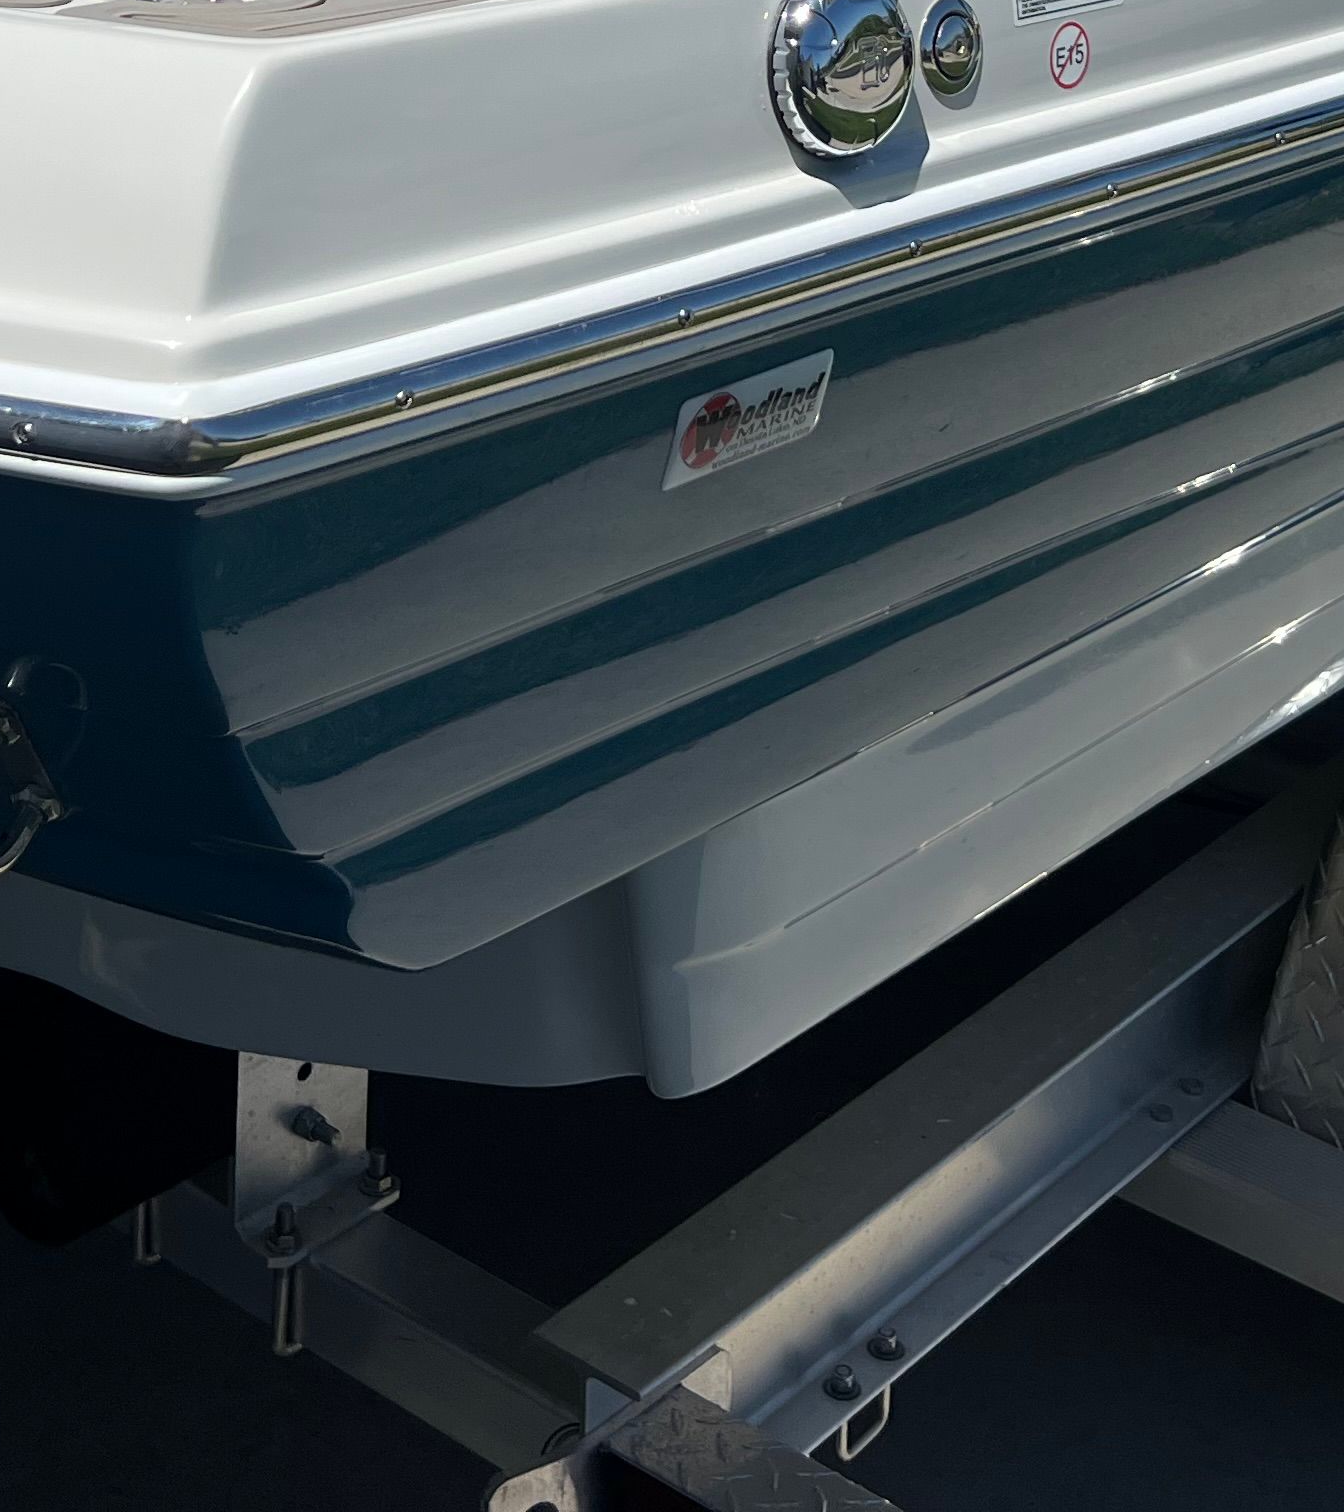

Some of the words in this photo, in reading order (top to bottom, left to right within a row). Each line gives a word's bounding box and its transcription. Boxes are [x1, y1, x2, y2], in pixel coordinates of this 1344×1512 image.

[1056, 43, 1084, 68] E15
[696, 371, 826, 453] Woodland
[736, 400, 817, 439] MARINE
